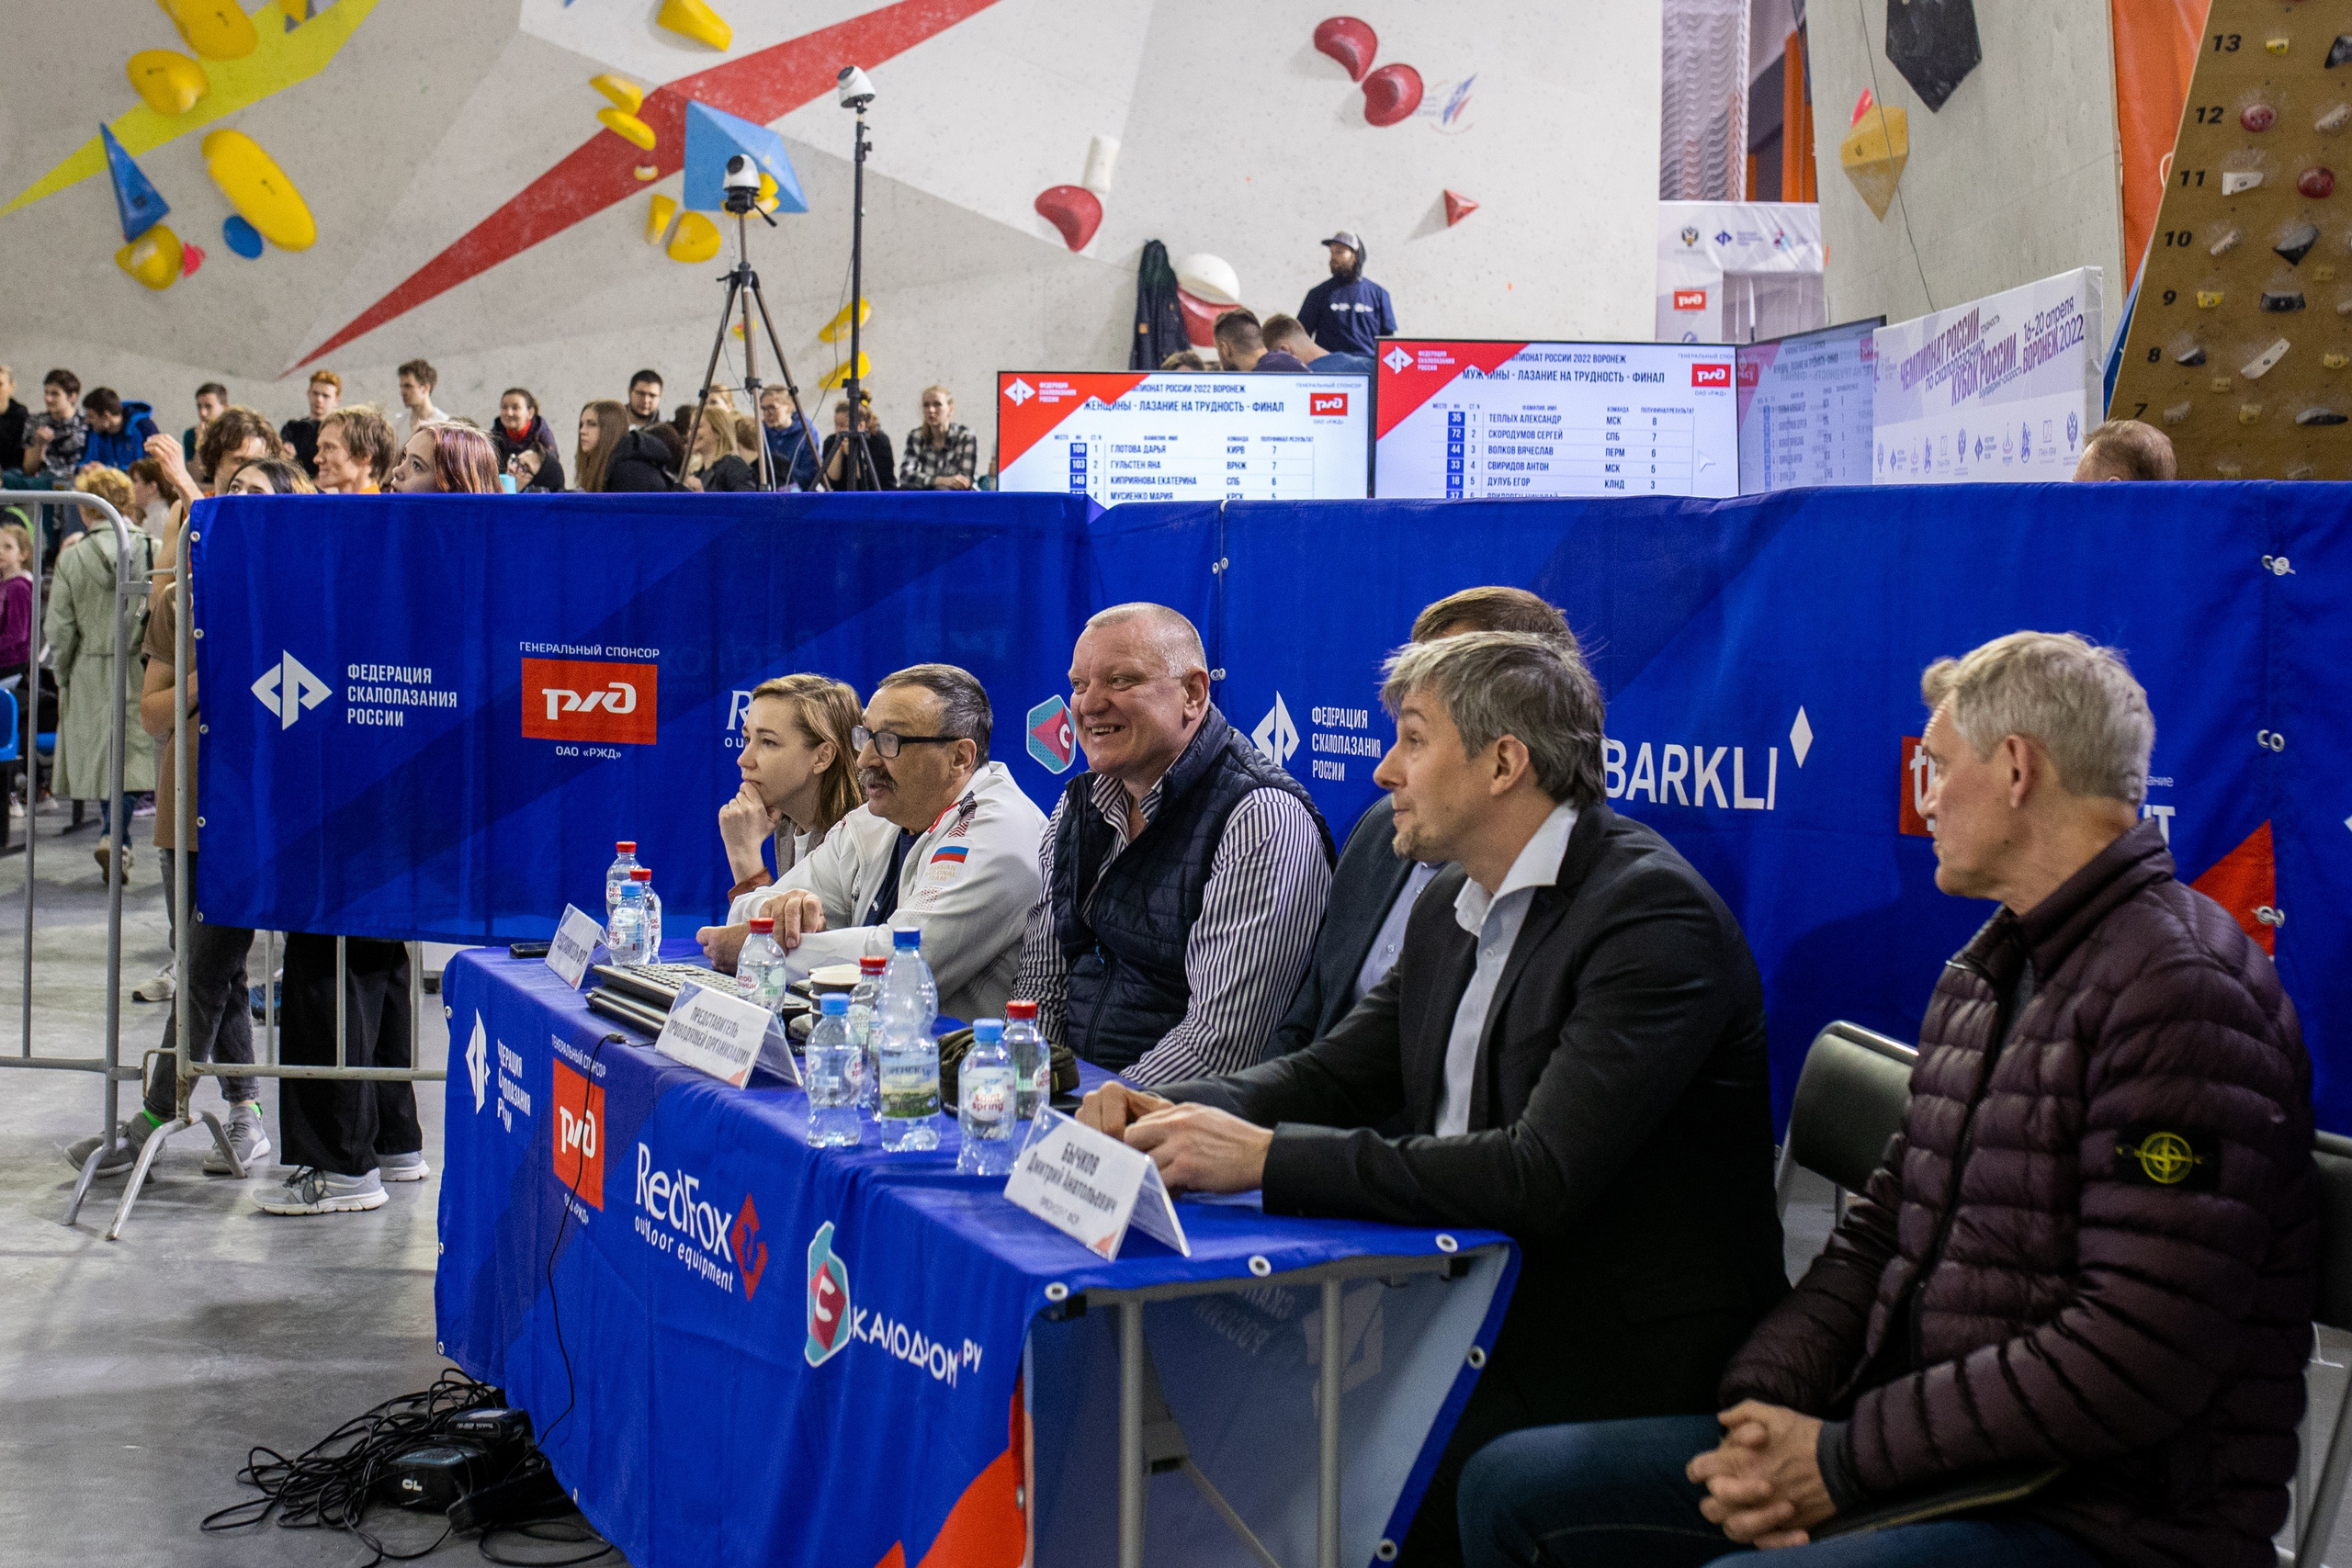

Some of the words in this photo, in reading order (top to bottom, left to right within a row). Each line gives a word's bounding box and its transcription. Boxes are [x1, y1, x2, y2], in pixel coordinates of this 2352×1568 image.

[2212, 35, 2241, 51] 13
[2195, 107, 2223, 124] 12
[2180, 171, 2205, 186] 11
[2164, 231, 2192, 246] 10
[2163, 290, 2177, 305] 9
[2023, 311, 2043, 343] 16-20
[2045, 296, 2075, 333] апреля
[1900, 330, 1945, 392] ЧЕМПИОНАТ
[1946, 307, 1980, 358] РОССИИ
[2023, 329, 2058, 374] ВОРОНЕЖ
[2059, 314, 2084, 352] 2022
[1545, 354, 1572, 363] РОССИИ
[1574, 355, 1591, 363] 2022
[1593, 355, 1626, 364] ВОРОНЕЖ
[2147, 347, 2161, 363] 8
[1926, 373, 1934, 393] по
[1933, 340, 1985, 386] скалолазанию
[1951, 356, 1978, 407] КУБОК
[1980, 333, 2017, 390] РОССИИ
[1518, 370, 1557, 381] ЛАЗАНИЕ
[1560, 371, 1571, 382] НА
[1575, 371, 1624, 383] ТРУДНОСТЬ
[1633, 372, 1665, 383] ФИНАЛ
[1166, 385, 1192, 393] РОССИИ
[1193, 385, 1211, 393] 2022
[1213, 385, 1246, 393] ВОРОНЕЖ
[1083, 400, 1131, 412] ЖЕНЩИНЫ
[1139, 401, 1179, 412] ЛАЗАНИЕ
[1182, 401, 1193, 411] НА
[1195, 401, 1244, 412] ТРУДНОСТЬ
[1252, 402, 1283, 412] ФИНАЛ
[2133, 403, 2148, 419] 7
[1452, 413, 1462, 422] 35
[1489, 414, 1518, 423] ТЕПЛЫХ
[1520, 414, 1562, 424] АЛЕКСАНДР
[1607, 416, 1622, 425] МСК
[1452, 429, 1461, 437] 72
[1472, 429, 1476, 437] 2
[1488, 430, 1535, 440] СКОРОДУМОВ
[1537, 430, 1563, 440] СЕРГЕЙ
[1606, 433, 1620, 441] СПБ
[1653, 433, 1657, 442] 7
[1111, 446, 1141, 454] ГЛОТОВА
[1143, 446, 1166, 454] ДАРЬЯ
[1272, 446, 1276, 455] 7
[1451, 445, 1461, 453] 44
[1471, 446, 1476, 454] 3
[1488, 446, 1516, 455] ВОЛКОВ
[1518, 446, 1554, 456] ВЯЧЕСЛАВ
[1606, 448, 1625, 457] ПЕРМ
[1111, 461, 1146, 469] ГУЛЬСТЕН
[1148, 461, 1160, 469] ЯНА
[1272, 462, 1276, 470] 7
[1451, 460, 1460, 468] 33
[1471, 461, 1476, 469] 4
[1487, 462, 1525, 471] СВИРИДОВ
[1527, 462, 1549, 471] АНТОН
[1605, 464, 1620, 472] МСК
[1158, 477, 1197, 486] ЕКАТЕРИНА
[1487, 478, 1511, 487] ДУЛУБ
[1513, 478, 1531, 486] ЕГОР
[1605, 479, 1625, 490] КЛНД
[1150, 492, 1173, 501] МАРИЯ
[520, 642, 602, 656] ГЕНЕРАЛЬНЫЙ
[605, 646, 660, 659] СПОНСОР
[347, 663, 432, 684] ФЕДЕРАЦИЯ
[347, 686, 457, 707] СКАЛОЛАЗАНИЯ
[542, 682, 637, 720] РЖД
[347, 708, 403, 727] РОССИИ
[1312, 706, 1368, 729] ФЕДЕРАЦИЯ
[1312, 733, 1381, 758] СКАЛОЛАЗАНИЯ
[556, 746, 579, 756] ОАО
[583, 748, 621, 760] «РЖД»
[1313, 760, 1344, 781] РОССИИ
[1600, 739, 1778, 810] BARKLI
[690, 1007, 739, 1038] ПРЕДСТАВИТЕЛЬ
[666, 1020, 707, 1048] ПРОВОДЯЩЕЙ
[705, 1035, 752, 1066] ОРГАНИЗАЦИИ
[551, 1033, 582, 1066] ГЕНЕРАЛЬНЫЙ
[975, 1093, 1000, 1102] saint
[972, 1101, 1004, 1111] spring
[636, 1142, 732, 1263] RedFox
[678, 1243, 733, 1293] equipment
